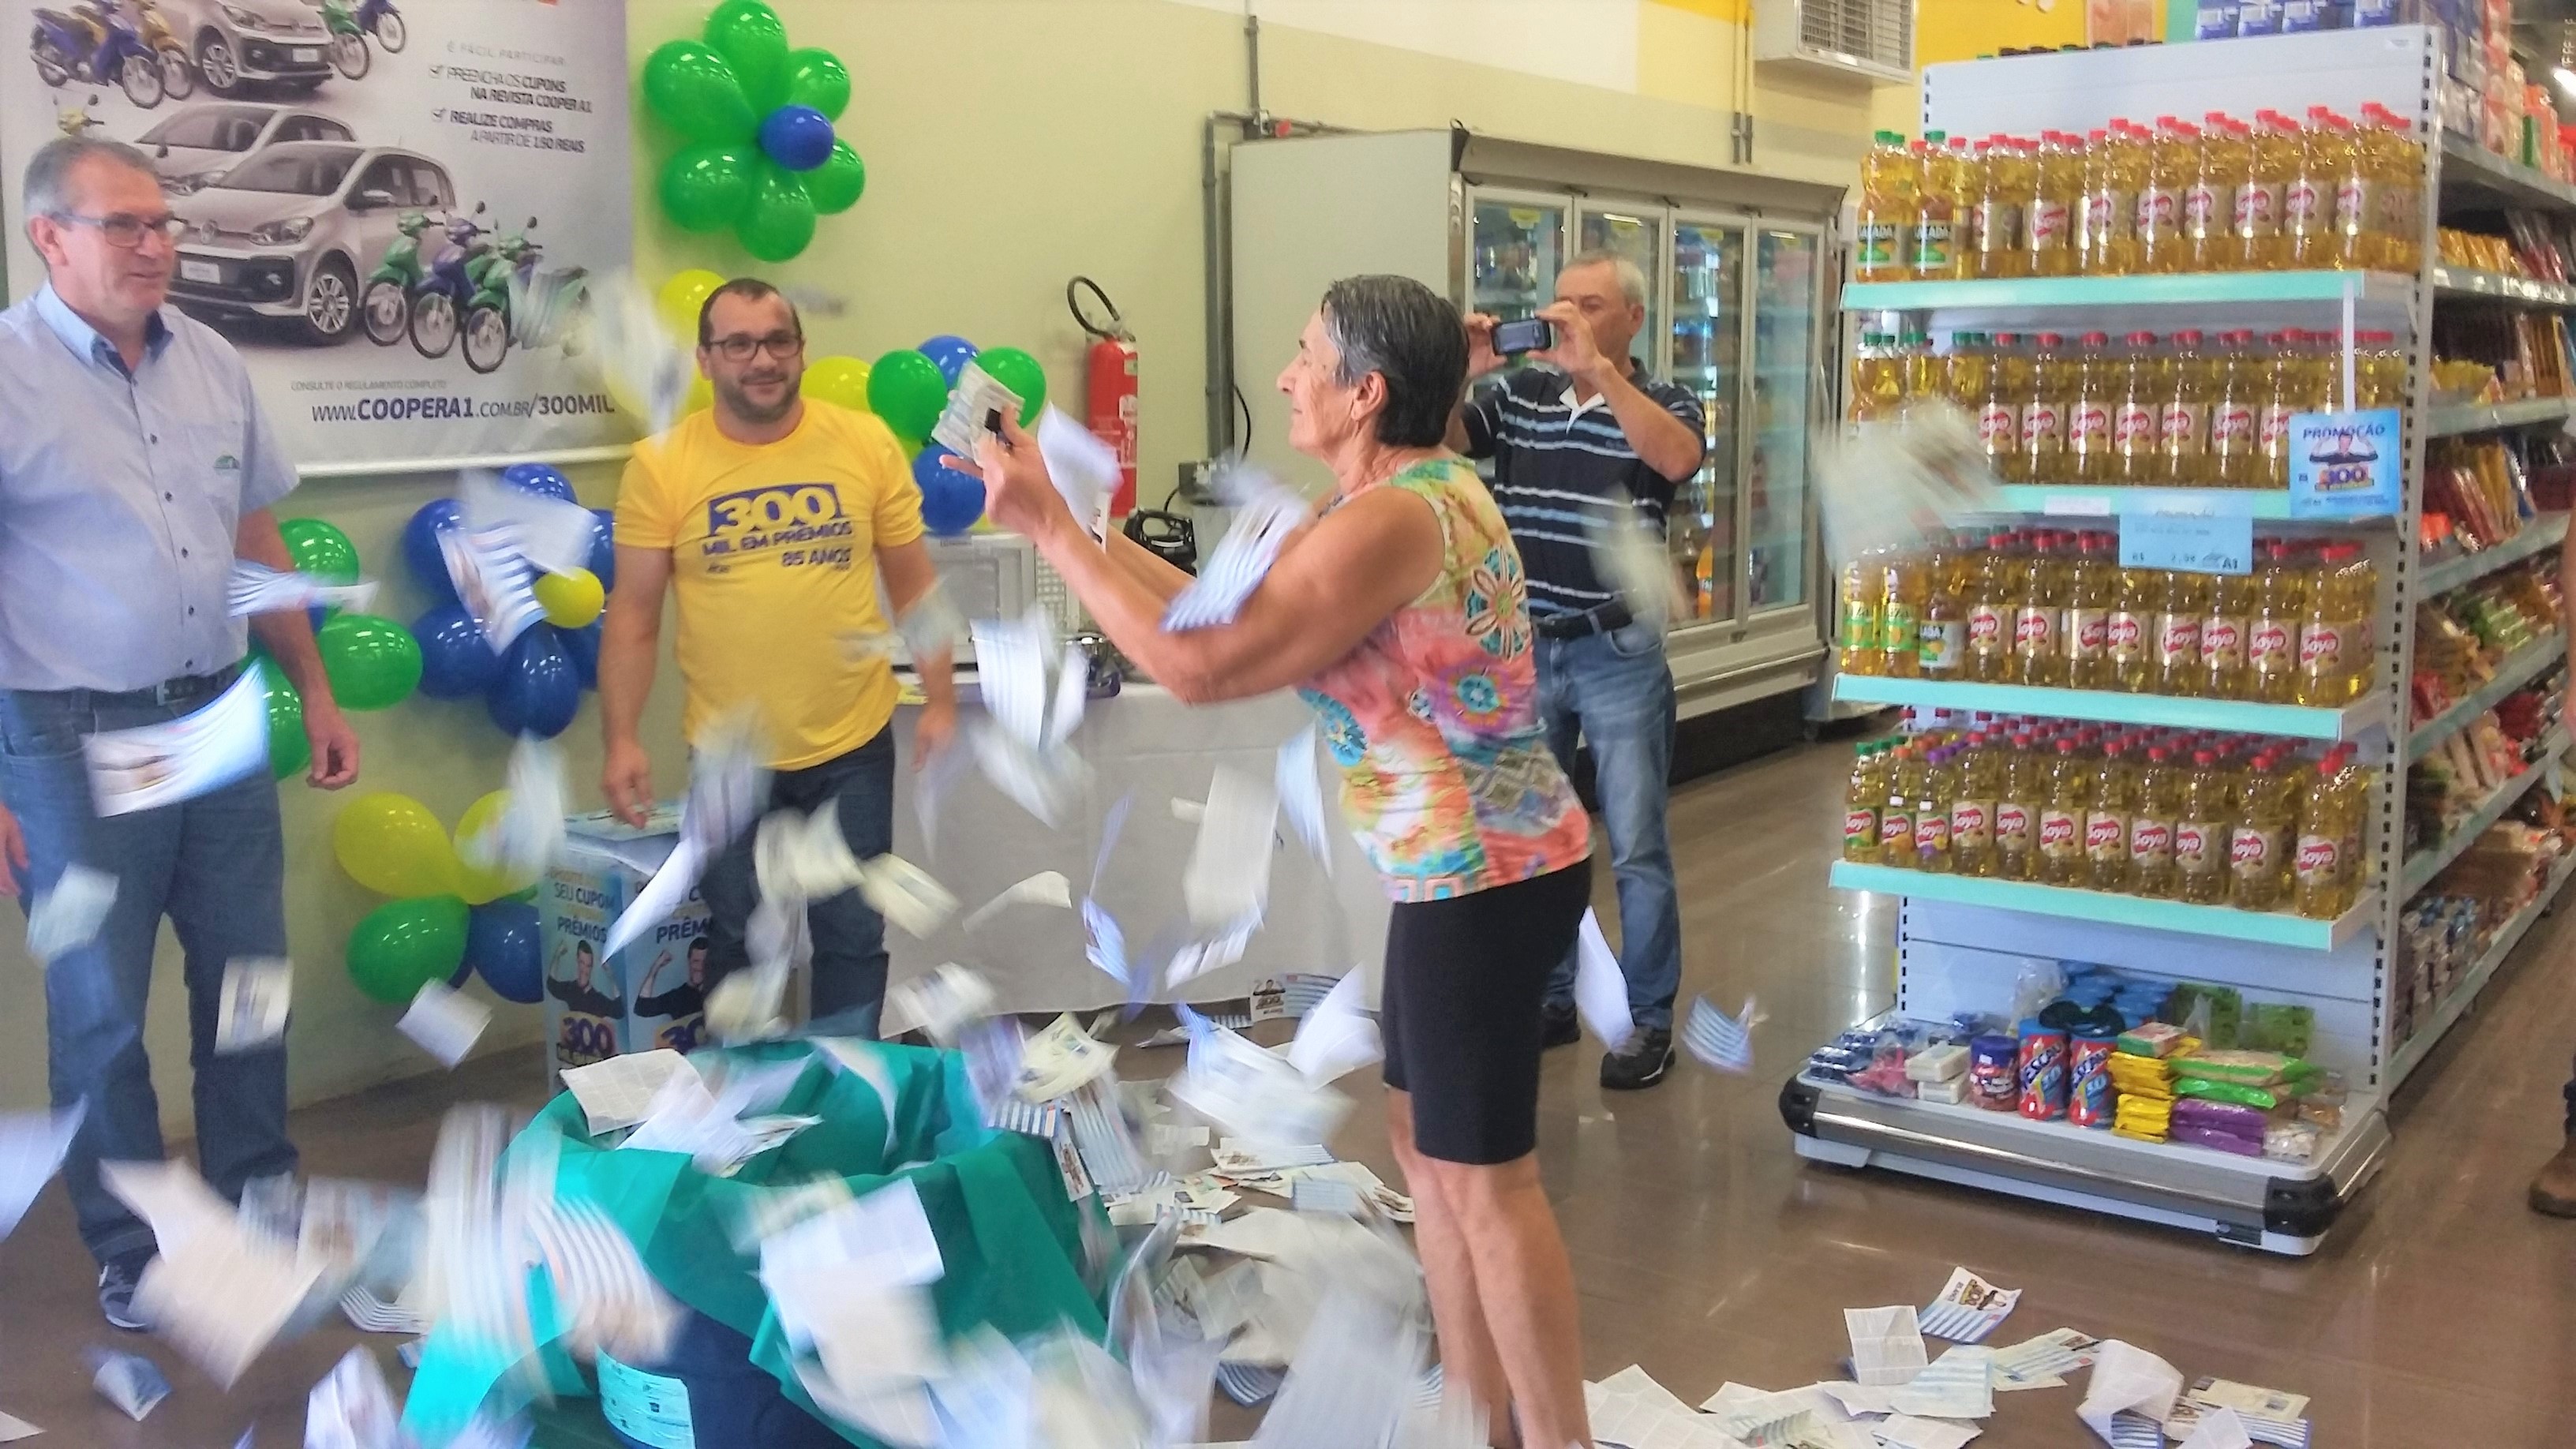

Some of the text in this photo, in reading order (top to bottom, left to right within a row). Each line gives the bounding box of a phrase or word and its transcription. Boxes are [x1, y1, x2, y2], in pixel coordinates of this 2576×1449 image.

[447, 66, 567, 93] PREENCHA OS CUPONS
[470, 86, 487, 99] NA
[489, 89, 534, 105] REVISTA
[450, 110, 553, 133] REALIZE COMPRAS
[515, 135, 530, 148] DE
[554, 137, 586, 153] REAIS
[715, 486, 837, 534] 300
[554, 882, 575, 902] SEU
[656, 916, 709, 944] PRÊM
